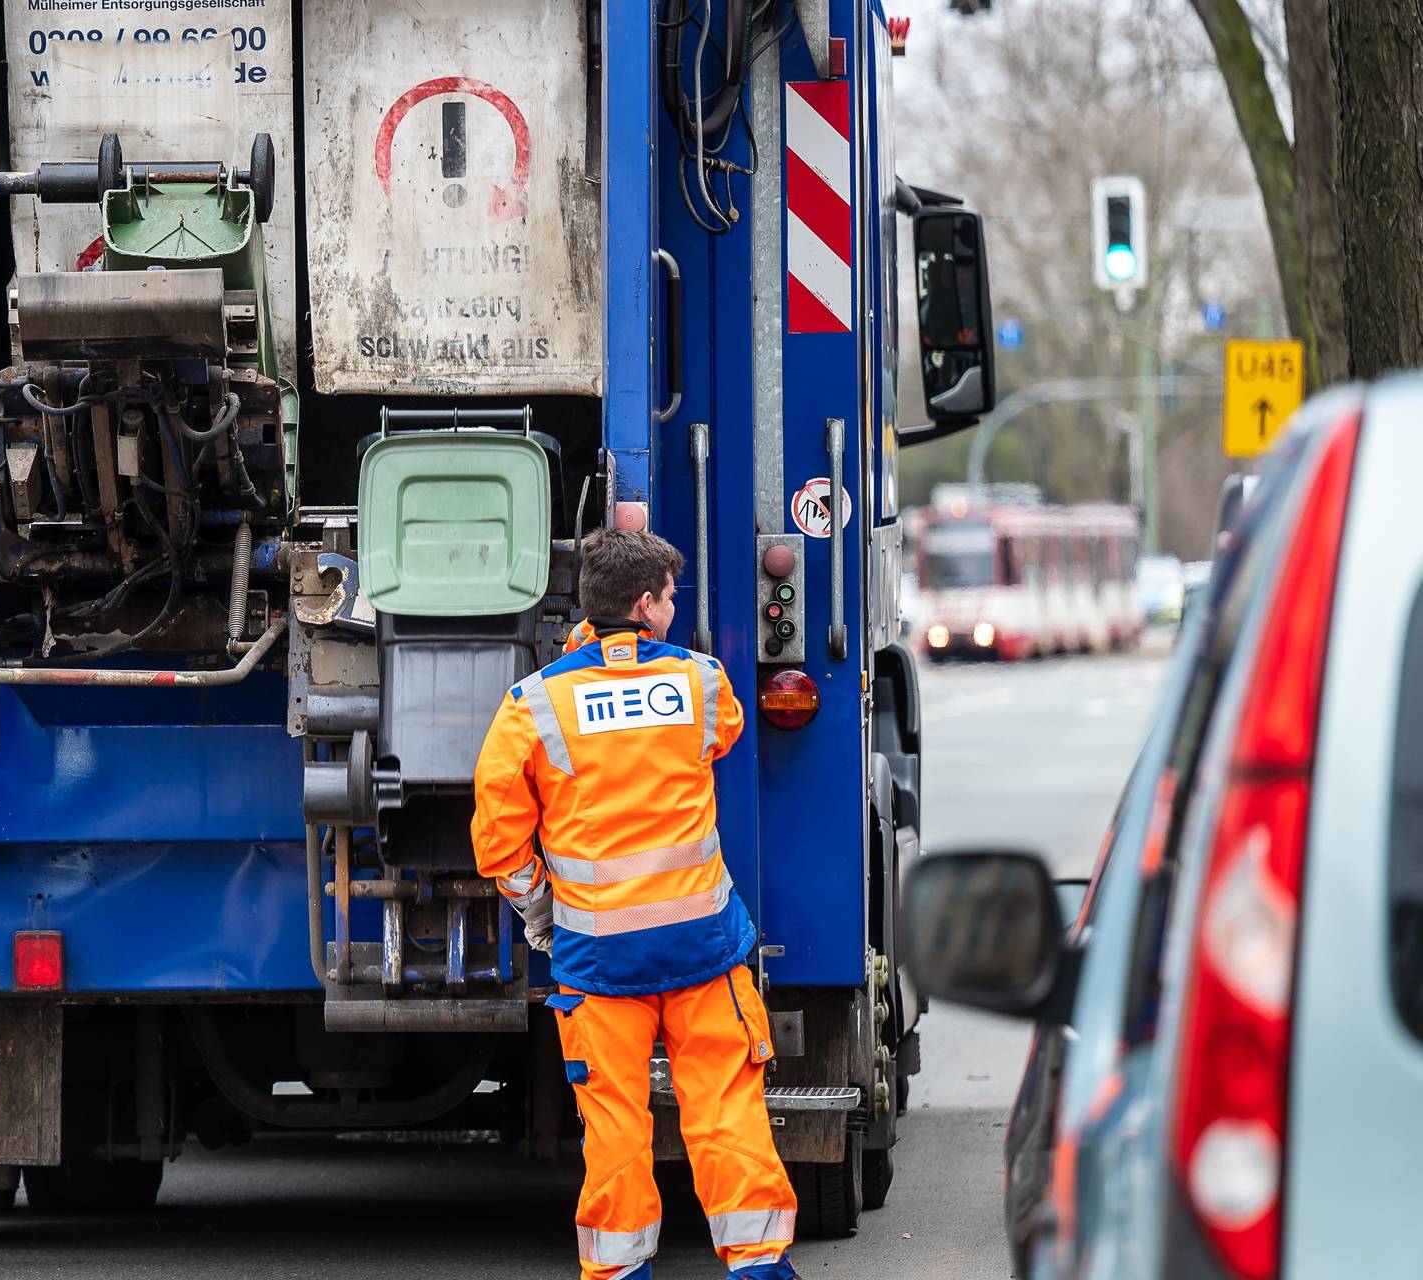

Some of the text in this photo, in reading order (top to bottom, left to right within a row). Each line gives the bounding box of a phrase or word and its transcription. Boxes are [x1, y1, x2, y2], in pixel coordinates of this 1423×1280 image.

[28, 0, 266, 12] Mülheimer Entsorgungsgesellschaft
[381, 244, 531, 276] HTUNG!
[360, 331, 558, 360] schwankt aus.
